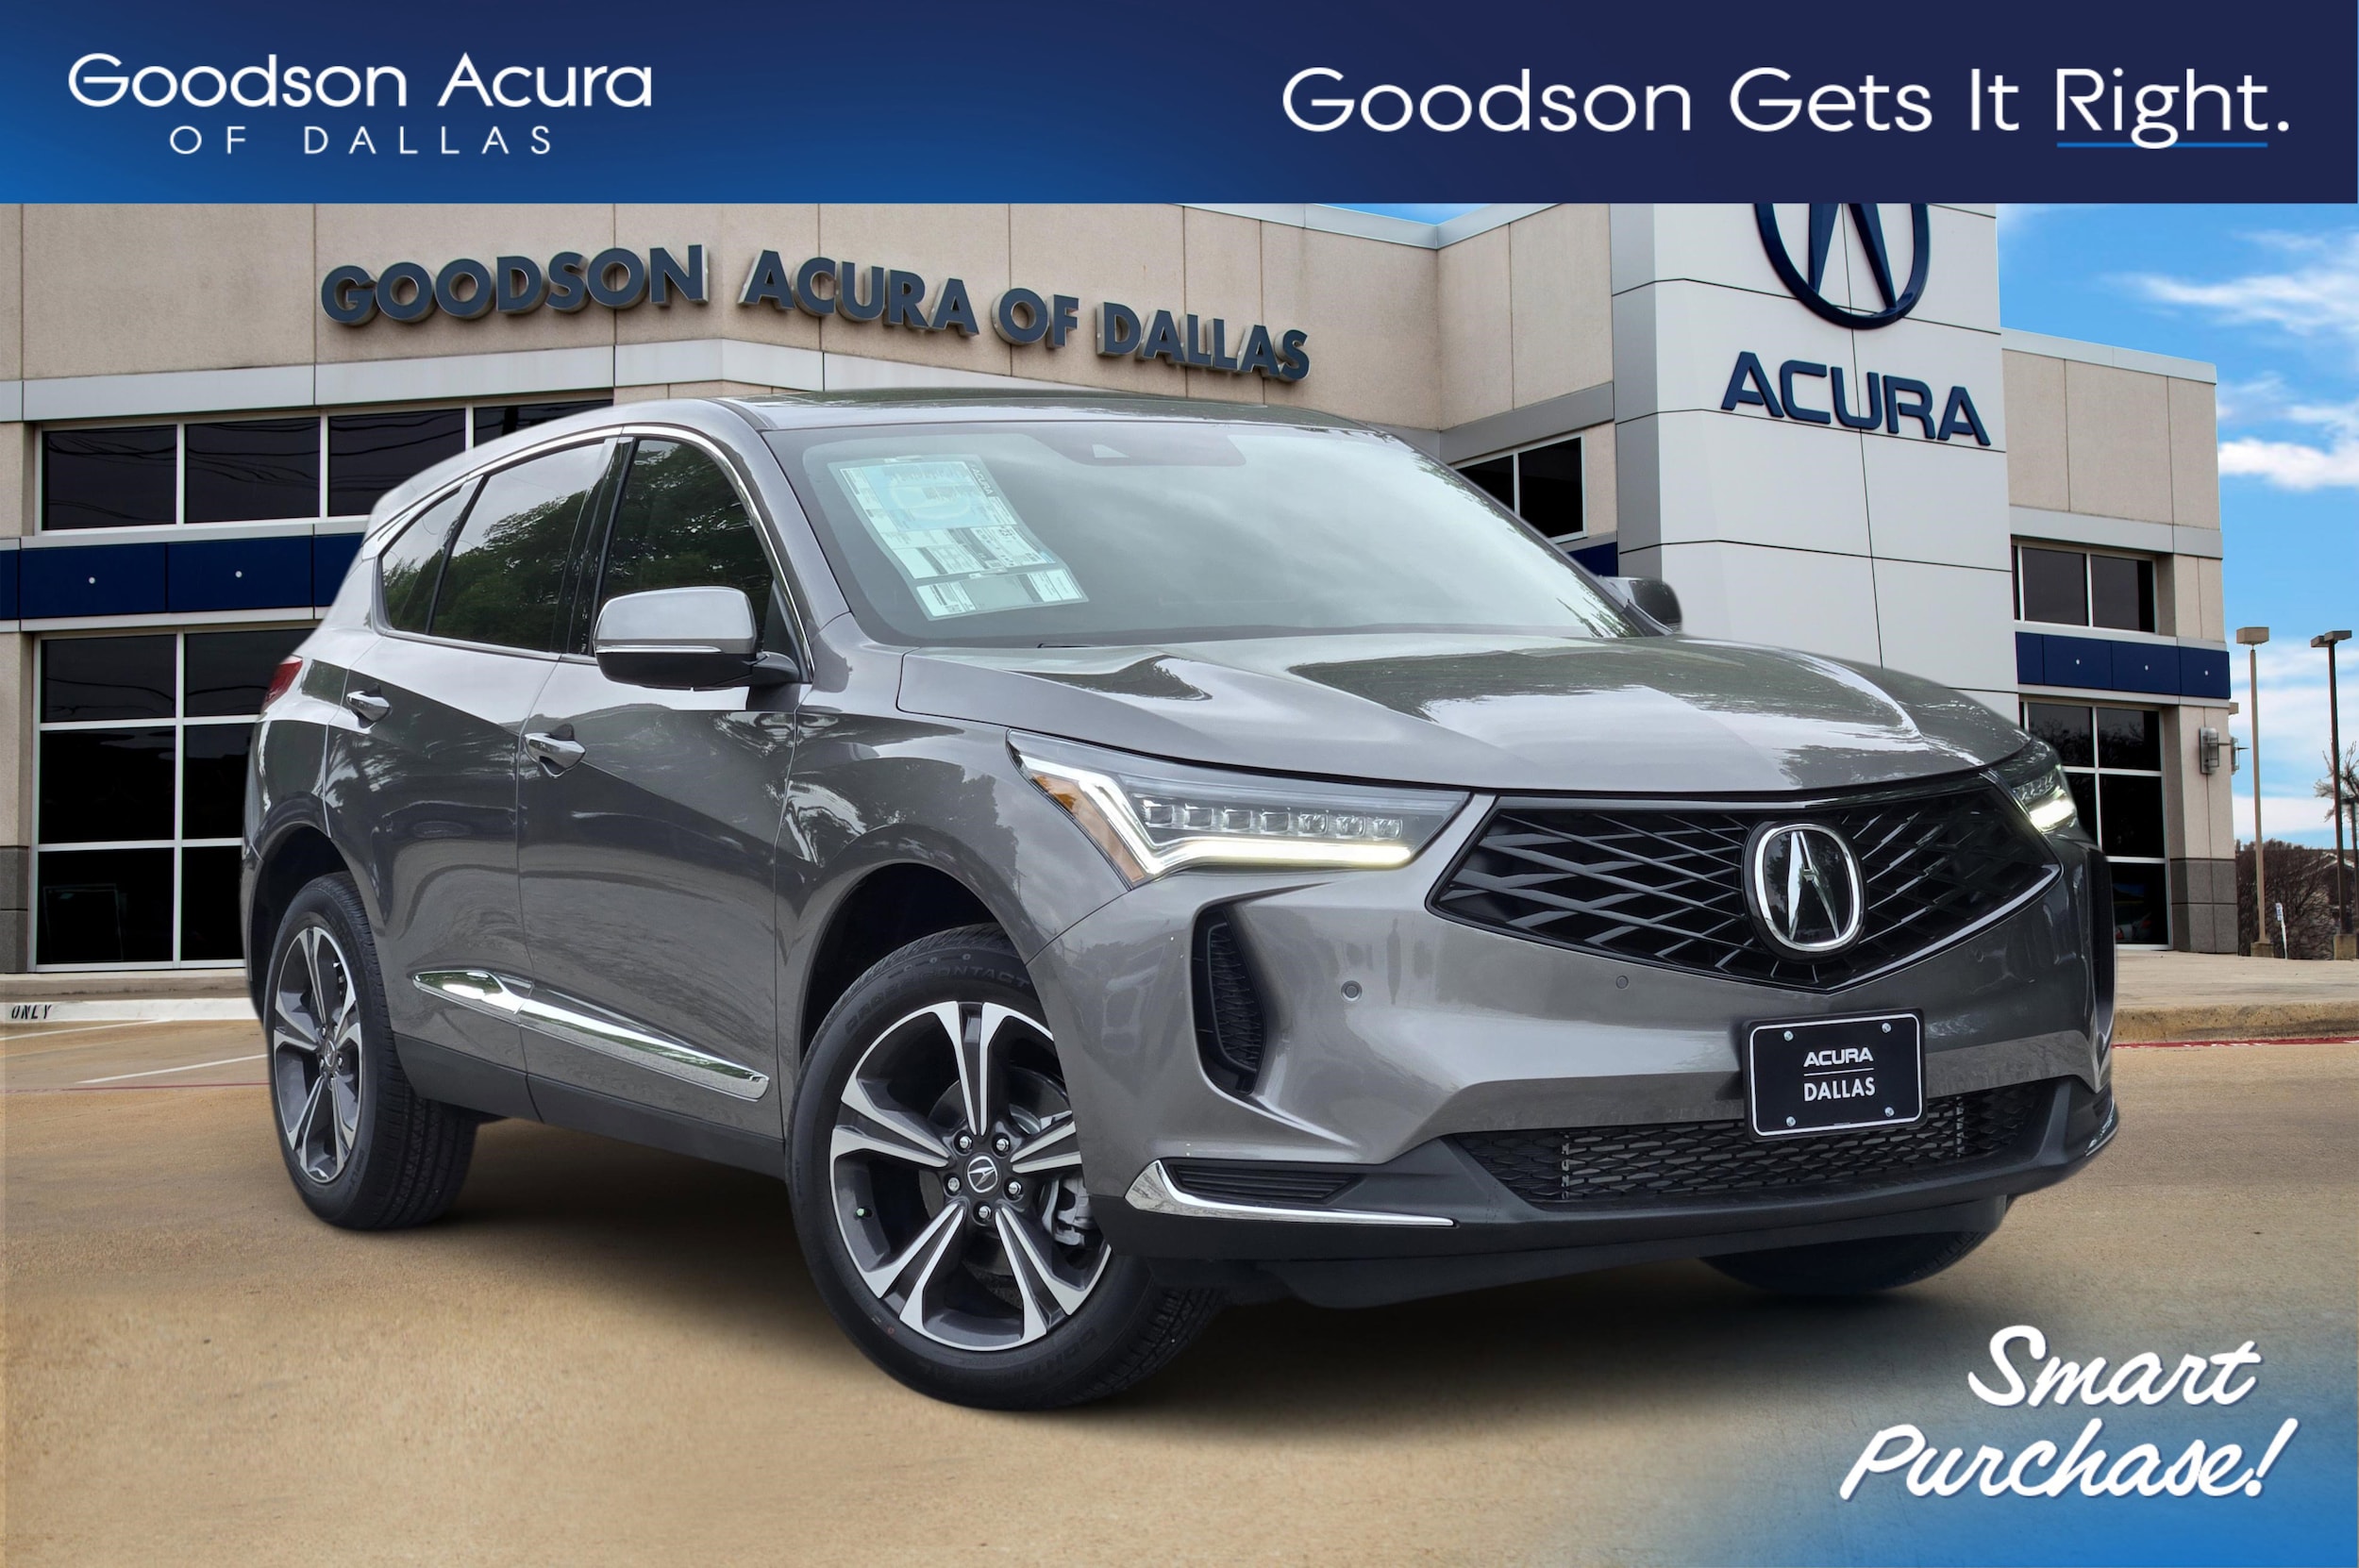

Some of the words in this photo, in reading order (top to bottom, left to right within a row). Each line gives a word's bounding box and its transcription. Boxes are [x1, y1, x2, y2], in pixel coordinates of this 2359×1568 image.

[322, 243, 710, 327] GOODSON
[738, 249, 980, 337] ACURA
[991, 288, 1079, 349] OF
[1096, 302, 1311, 382] DALLAS
[1720, 351, 1991, 446] ACURA
[971, 467, 995, 494] ACURA
[11, 1004, 52, 1020] ONLY
[1803, 1046, 1874, 1068] ACURA
[1803, 1076, 1876, 1102] DALLAS
